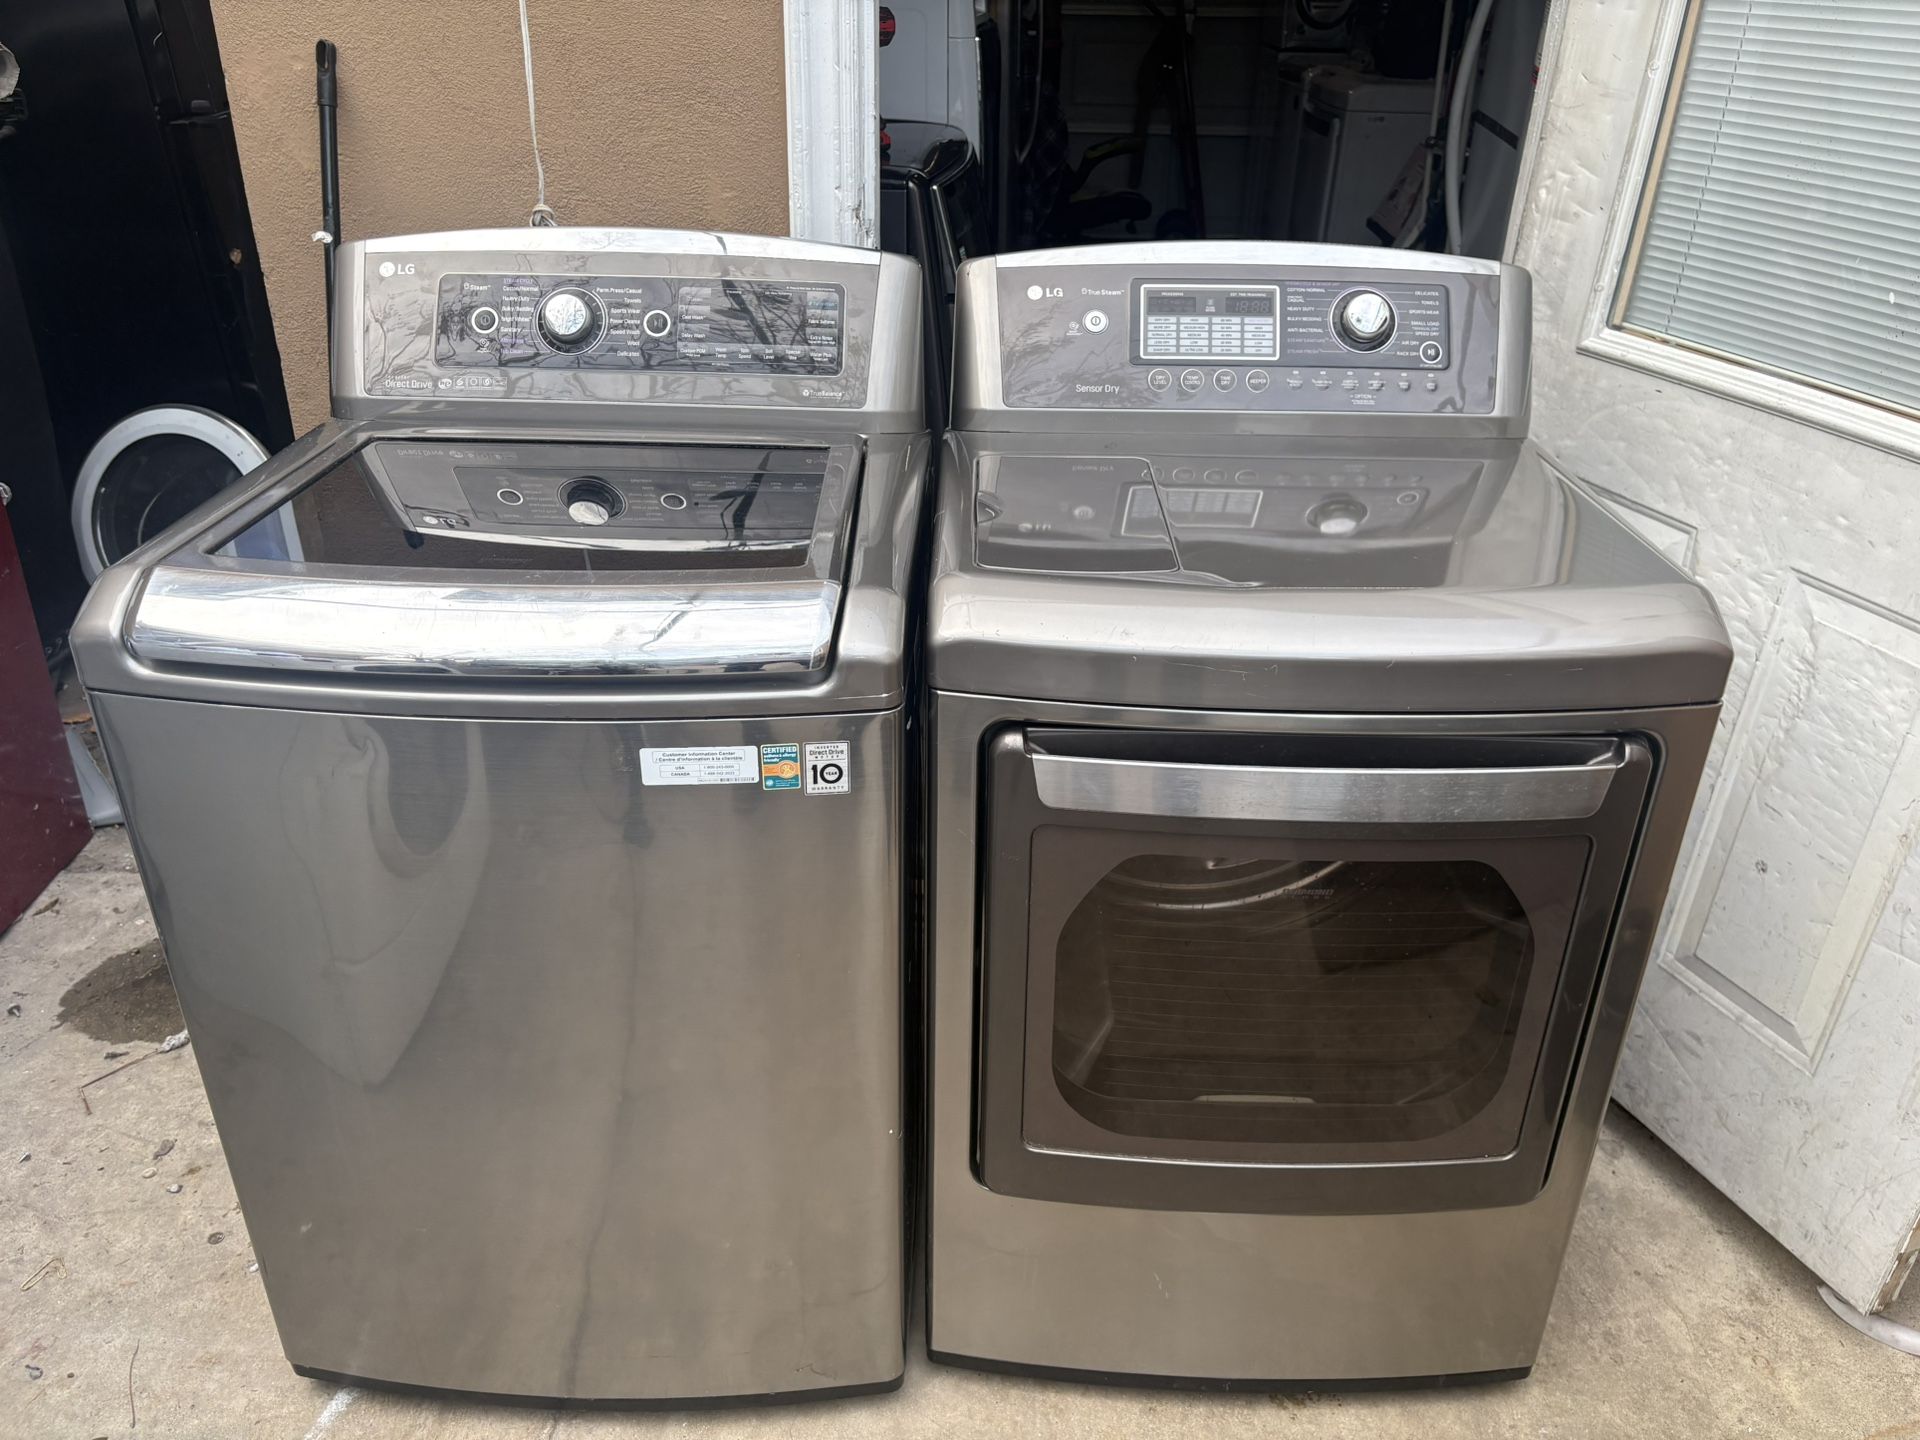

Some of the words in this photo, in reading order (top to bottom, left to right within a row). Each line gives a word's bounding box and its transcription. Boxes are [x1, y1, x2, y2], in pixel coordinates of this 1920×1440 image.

[397, 263, 415, 275] LG
[1046, 288, 1064, 298] LG
[385, 379, 411, 389] Direct
[412, 380, 433, 389] Drive
[1075, 384, 1103, 394] Sensor
[1104, 384, 1120, 395] Dry
[763, 746, 797, 754] CERTIFIED
[812, 762, 844, 785] 10
